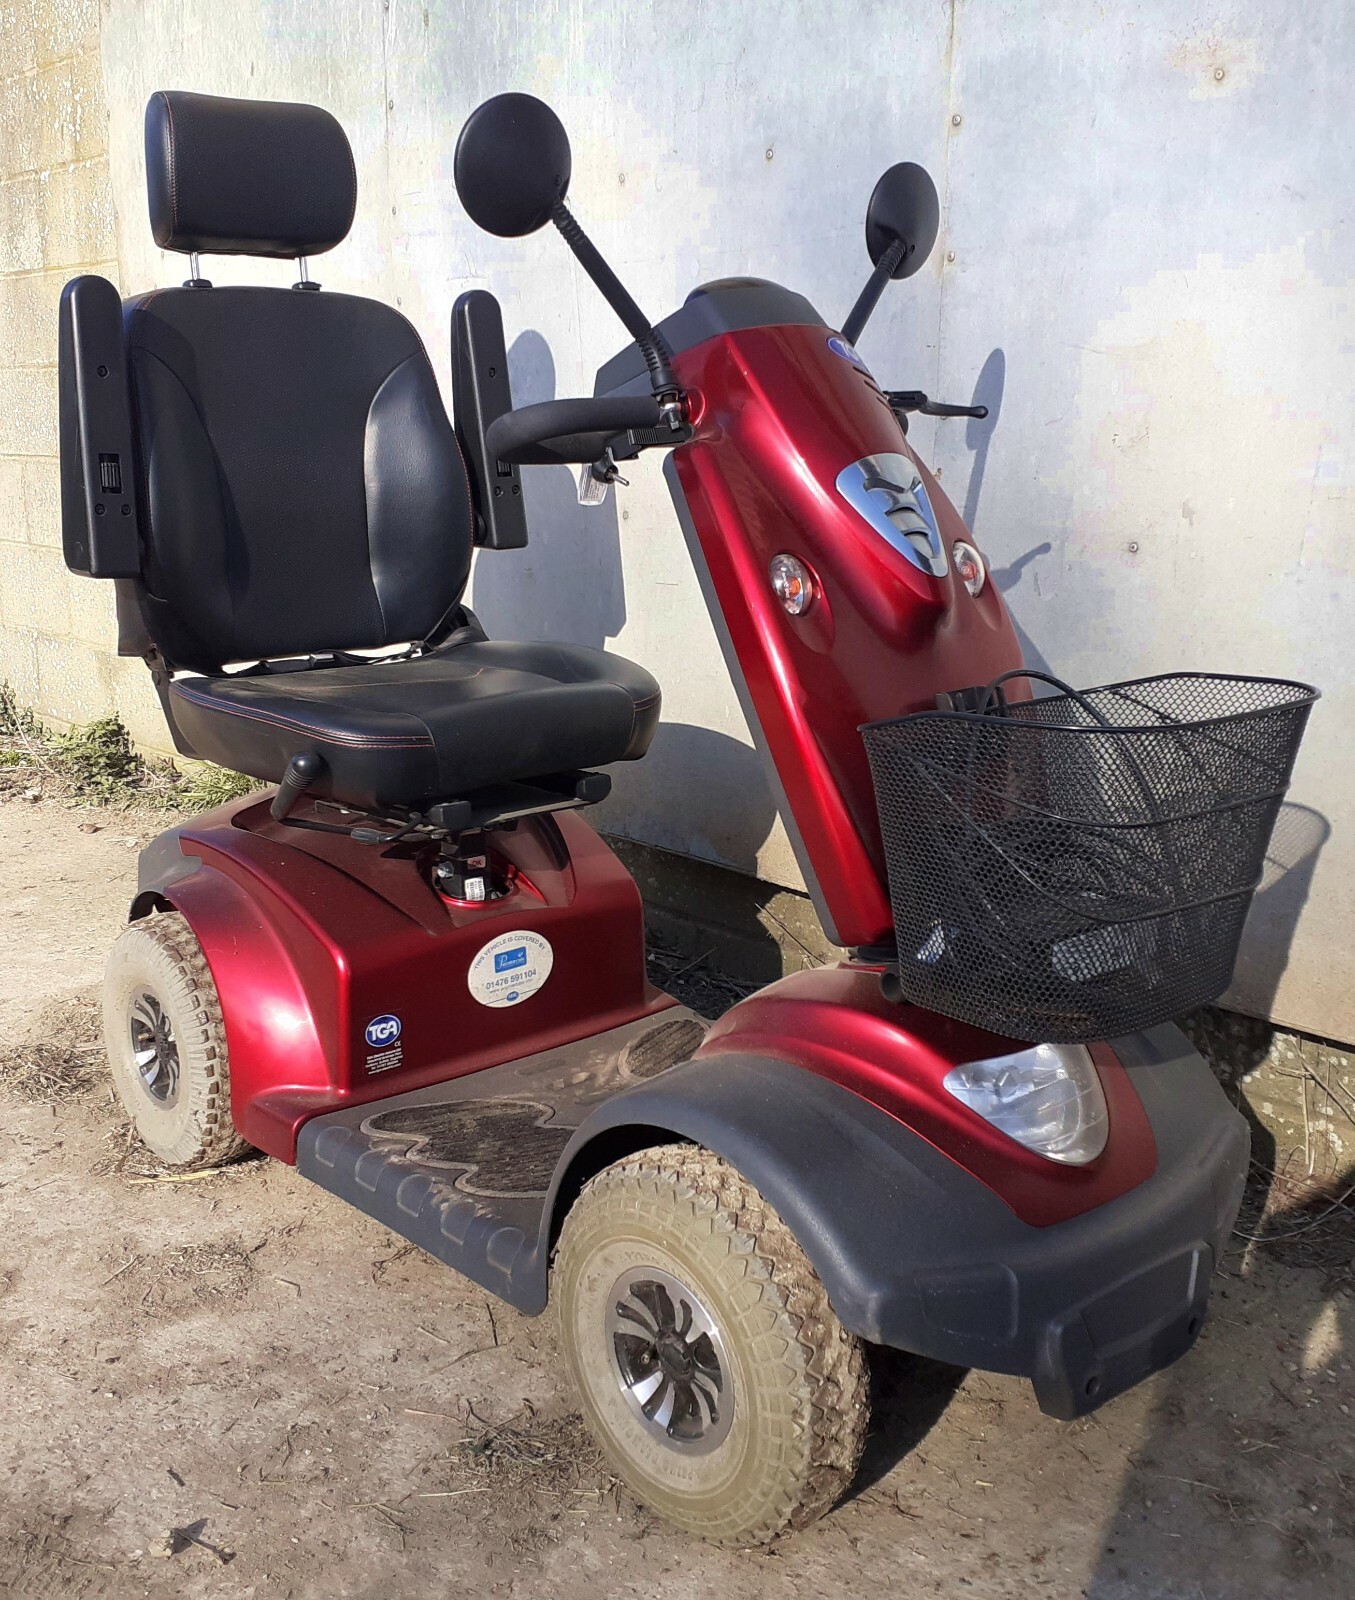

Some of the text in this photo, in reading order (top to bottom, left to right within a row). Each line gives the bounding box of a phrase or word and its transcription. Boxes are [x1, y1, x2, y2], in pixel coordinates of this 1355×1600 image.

[474, 956, 485, 970] THIS
[484, 938, 507, 956] VEHICLE
[513, 935, 540, 945] COVERED
[538, 942, 546, 951] BY
[485, 976, 509, 990] 01476
[510, 968, 537, 983] 591104
[368, 1020, 398, 1041] TGA
